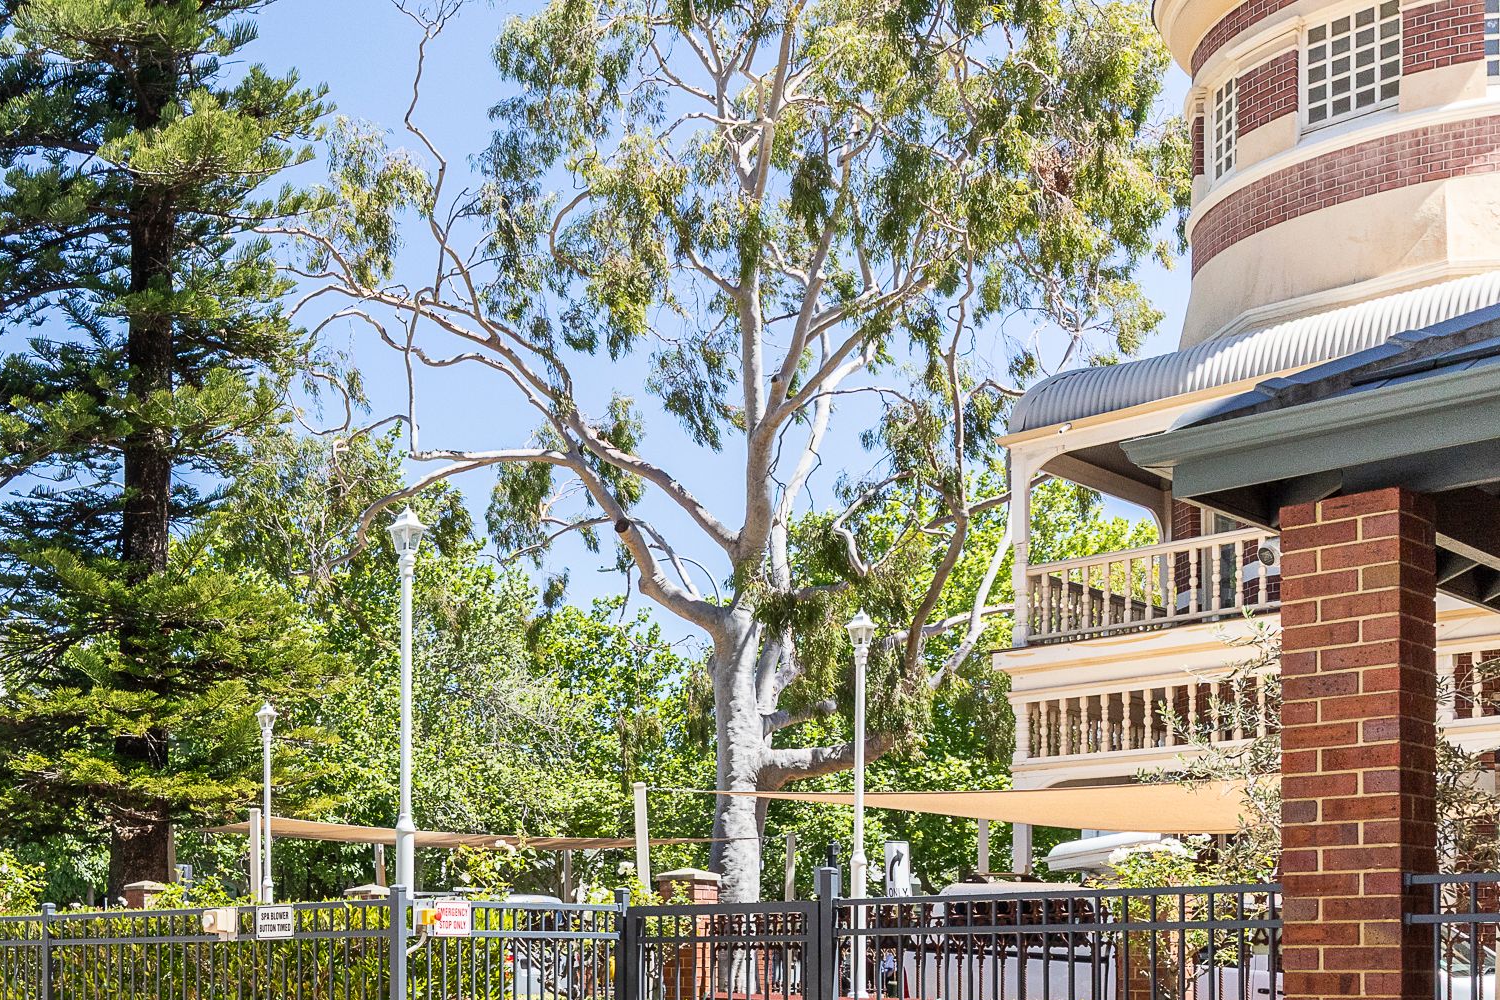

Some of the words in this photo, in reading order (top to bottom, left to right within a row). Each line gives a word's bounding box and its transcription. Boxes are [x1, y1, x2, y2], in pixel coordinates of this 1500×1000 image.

[260, 912, 270, 921] SPA
[270, 911, 289, 921] BLOWER
[259, 923, 277, 932] BUTTON
[277, 923, 291, 932] TIMED
[439, 920, 452, 929] STOP
[453, 920, 467, 930] ONLY
